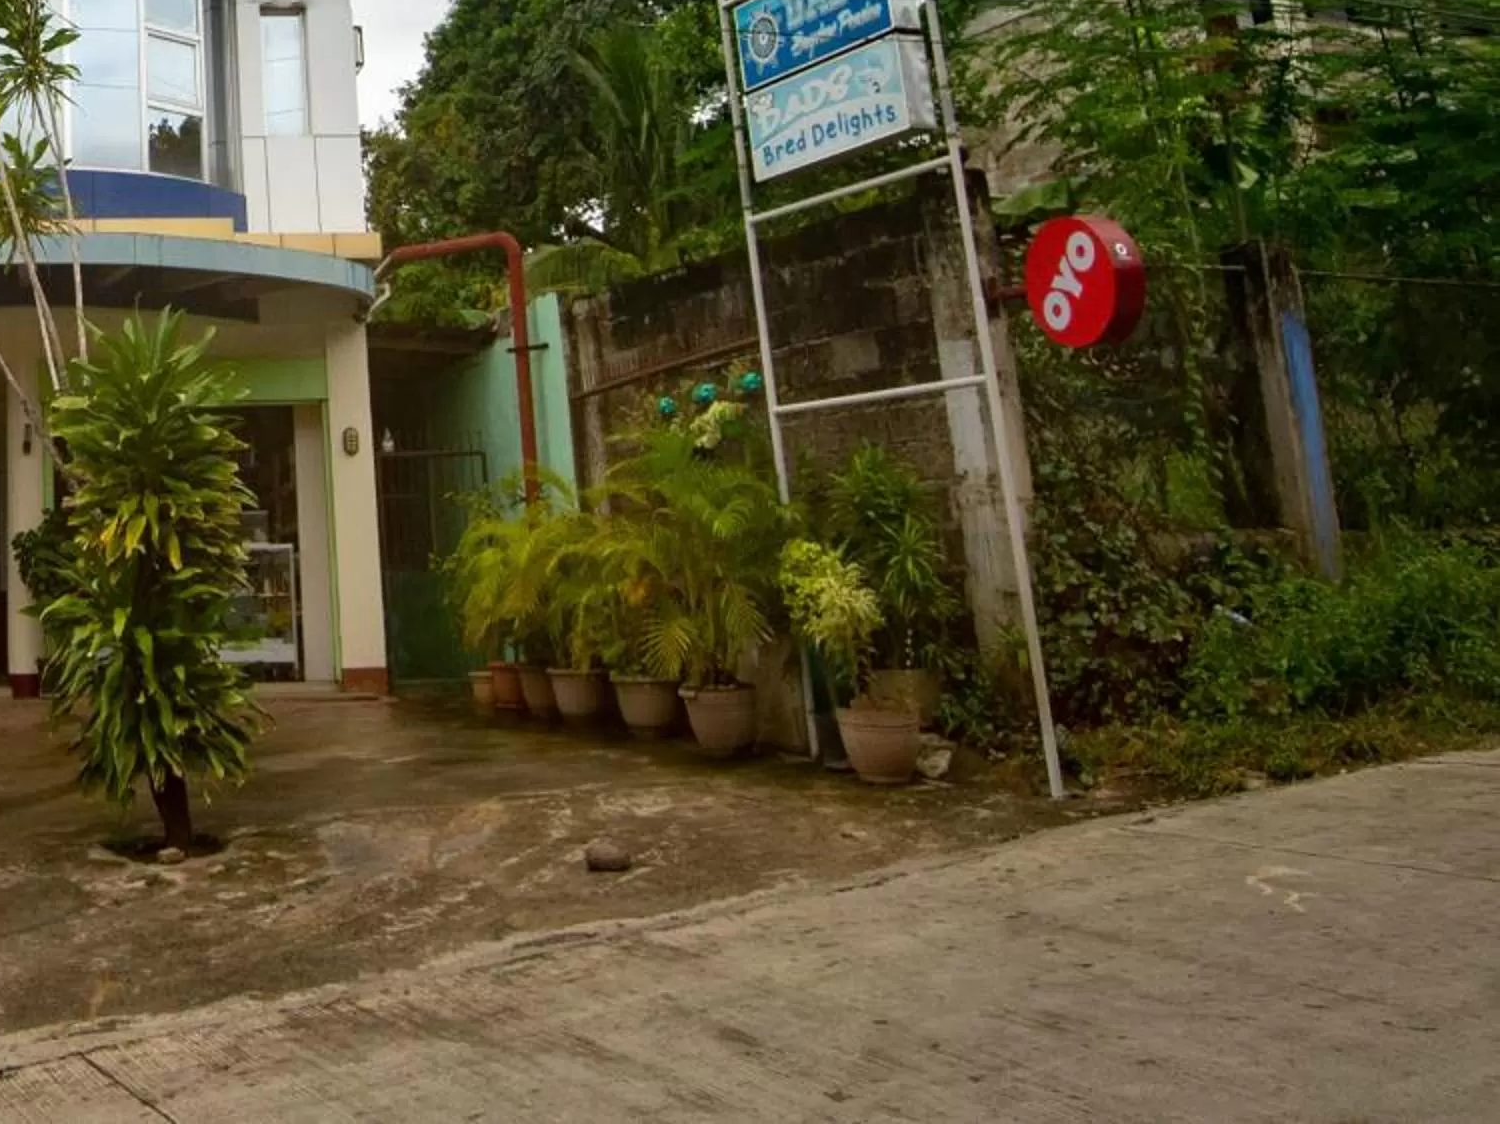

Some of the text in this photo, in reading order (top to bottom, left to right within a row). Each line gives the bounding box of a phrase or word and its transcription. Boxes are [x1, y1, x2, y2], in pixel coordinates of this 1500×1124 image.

[762, 104, 897, 166] Bred Delights
[1043, 230, 1095, 332] OYO
